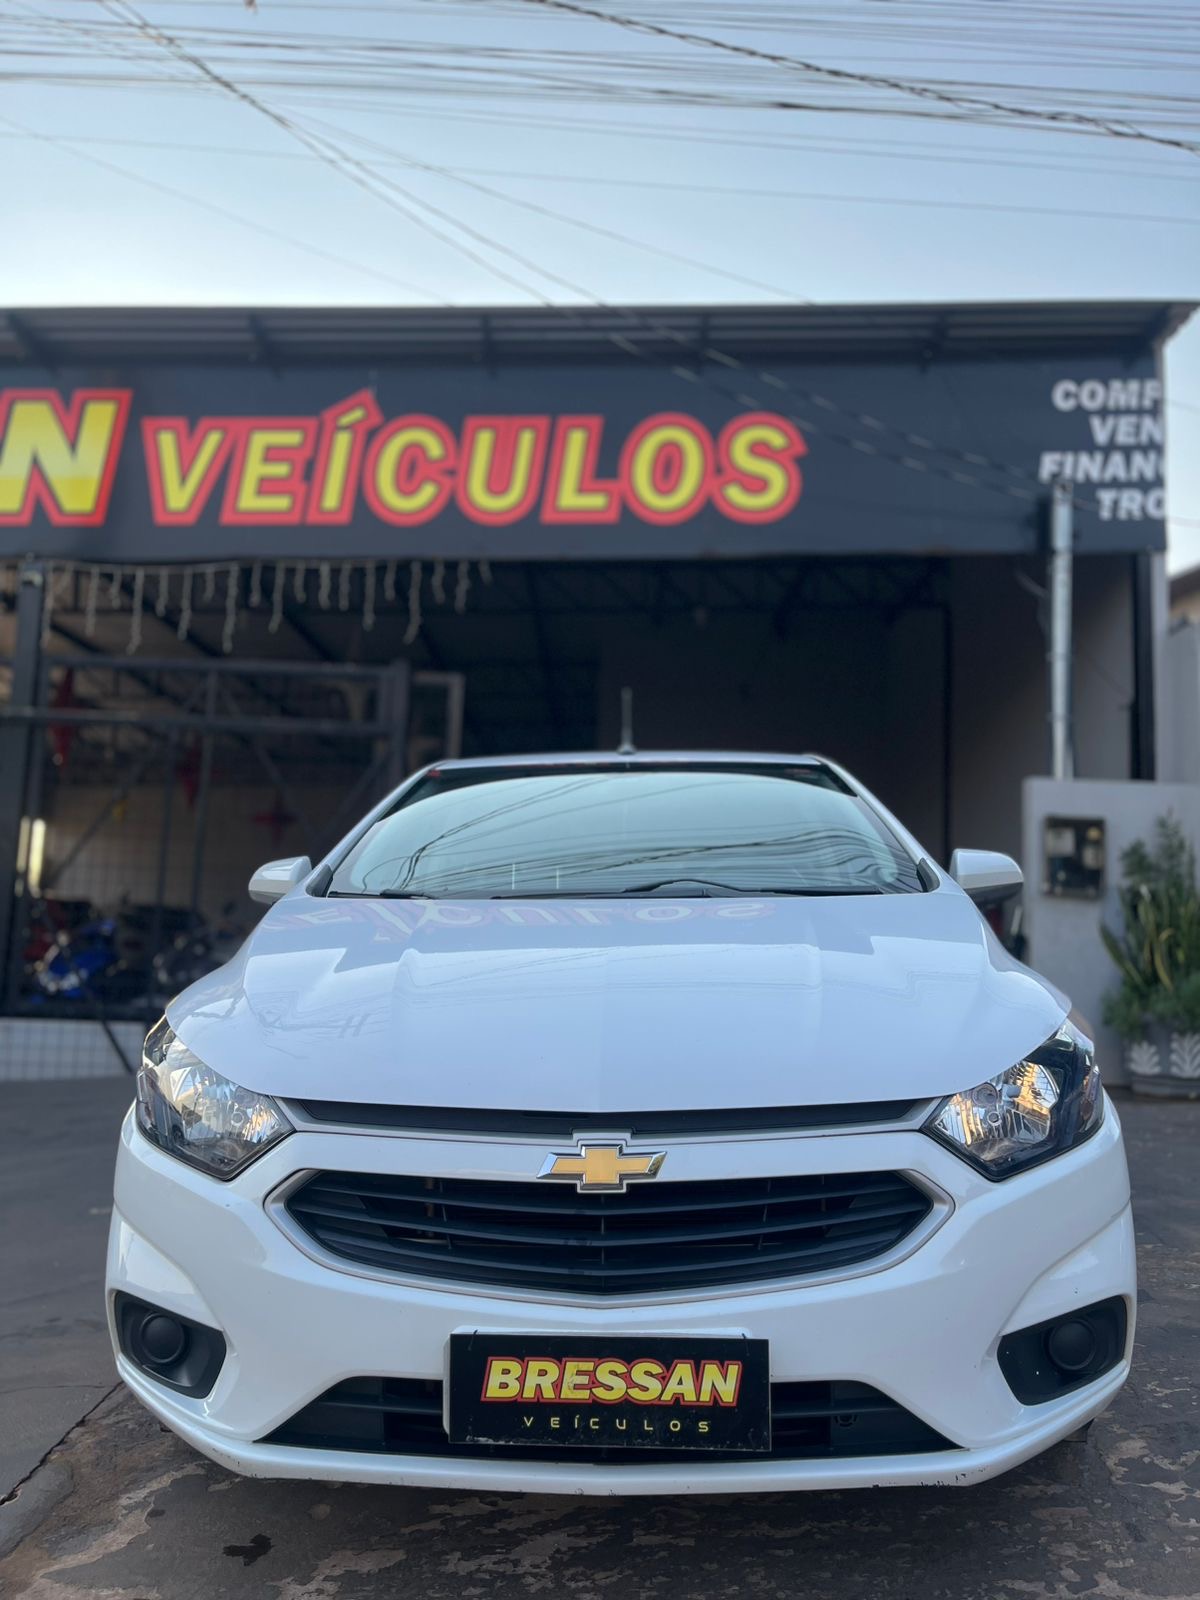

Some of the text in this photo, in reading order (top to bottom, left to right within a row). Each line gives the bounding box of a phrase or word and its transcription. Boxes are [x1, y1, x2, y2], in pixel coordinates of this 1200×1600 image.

[142, 390, 807, 525] VEÍCULOS
[1038, 450, 1165, 483] FINAN
[480, 1356, 742, 1406] BRESSAN
[523, 1415, 709, 1432] VEÍCULOS
